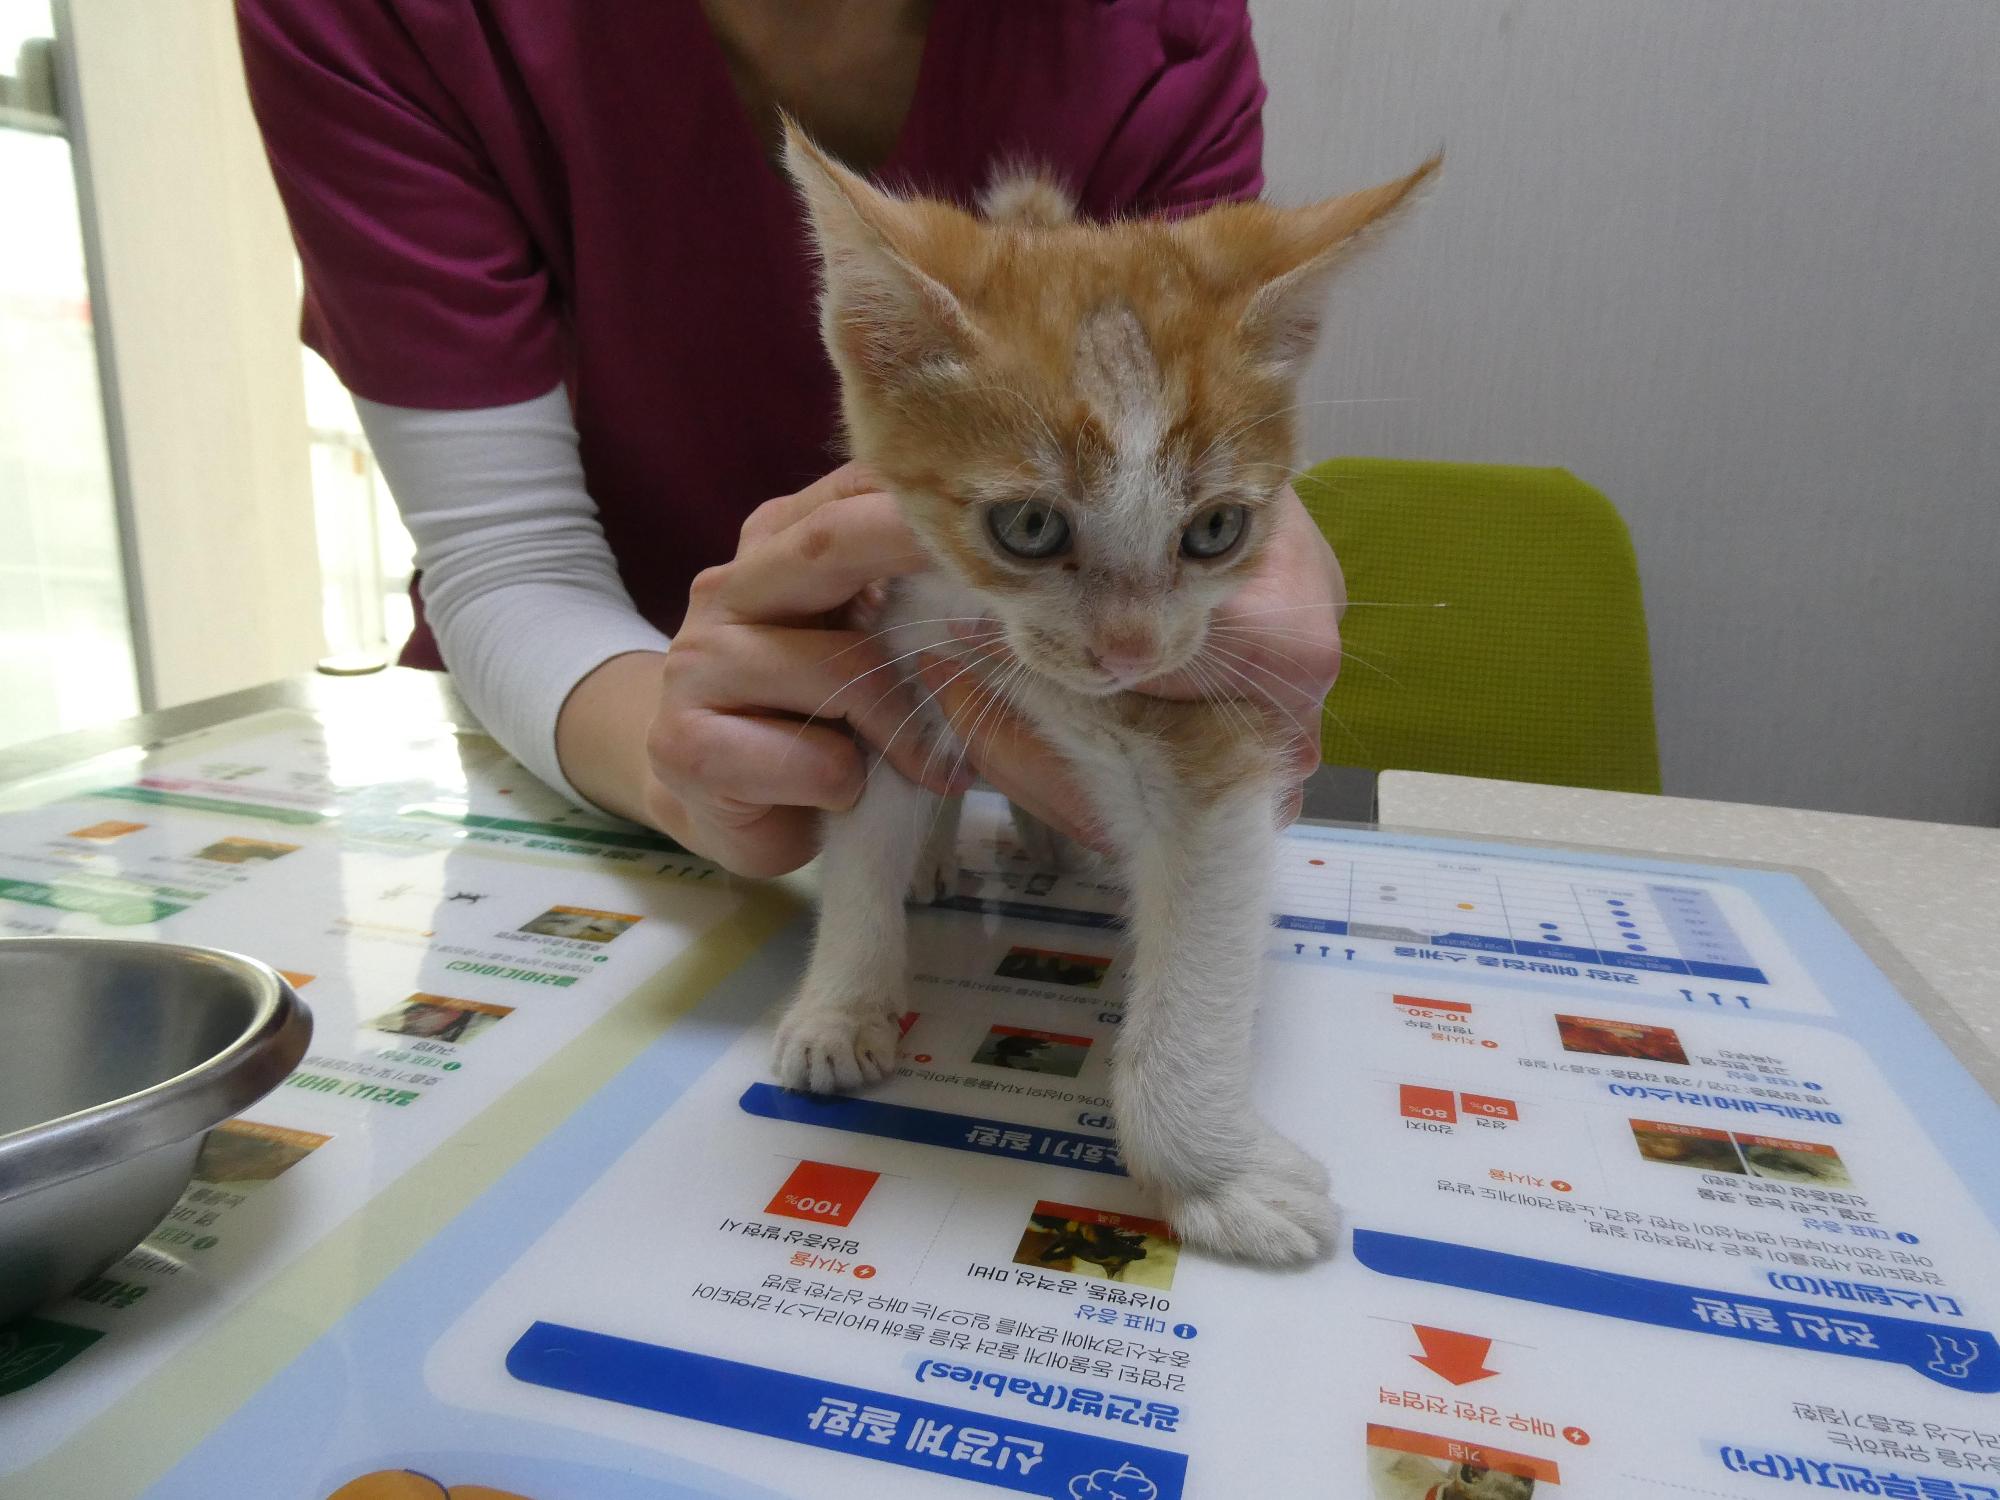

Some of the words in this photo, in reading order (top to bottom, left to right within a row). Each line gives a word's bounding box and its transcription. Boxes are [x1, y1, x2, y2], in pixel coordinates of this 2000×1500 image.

[1476, 955, 1578, 978] 예방접종
[1585, 968, 1639, 985] 권장
[1607, 1083, 1842, 1125] 아데노바이러스(A)
[1406, 1120, 1454, 1135] 강아지
[1476, 1118, 1507, 1131] 성견
[964, 1125, 1032, 1151] 질환
[1436, 1179, 1476, 1196] 발병
[1487, 1168, 1545, 1188] 치사율
[783, 1193, 843, 1217] 100%
[1790, 1188, 1869, 1207] 신경증상
[718, 1217, 740, 1233] 시
[742, 1222, 781, 1241] 발현
[1649, 1214, 1689, 1232] 약한
[1692, 1222, 1776, 1246] 면역성이
[1802, 1218, 1843, 1235] 증상
[1848, 1224, 1890, 1240] 대표
[781, 1229, 860, 1256] 임상증상
[1633, 1229, 1715, 1252] 치명적인
[1717, 1243, 1762, 1260] 높은
[1779, 1234, 1886, 1261] 강아지부터
[789, 1250, 850, 1275] 치사율
[1889, 1250, 1934, 1268] 어린
[761, 1273, 801, 1294] 질병
[966, 1262, 1009, 1282] 마비
[1013, 1268, 1078, 1296] 공격성,
[1857, 1262, 1946, 1287] 감염되면
[691, 1282, 773, 1311] 감염되어
[803, 1280, 864, 1305] 심각한
[866, 1293, 909, 1315] 매우
[1084, 1281, 1171, 1312] 이상행동,
[774, 1298, 880, 1333] 바이러스가
[911, 1301, 991, 1331] 일으키는
[1073, 1303, 1118, 1325] 증상
[1123, 1311, 1166, 1335] 대표
[1691, 1297, 1782, 1334] 질환
[881, 1319, 925, 1341] 통해
[927, 1329, 971, 1351] 침을
[995, 1316, 1059, 1345] 문제를
[1785, 1311, 1880, 1350] 전신
[975, 1337, 1020, 1361] 물려
[1061, 1329, 1191, 1369] 중추신경계에
[1024, 1346, 1114, 1378] 동물에게
[1118, 1364, 1187, 1392] 감염된
[914, 1359, 1180, 1433] 광견병(Rabies)
[1379, 1387, 1448, 1415] 전염력
[807, 1396, 901, 1445] 질환
[1453, 1400, 1502, 1426] 강한
[1505, 1414, 1556, 1438] 매우
[1923, 1423, 2000, 1448] 러스성
[905, 1417, 1044, 1476] 신경계
[1447, 1443, 1481, 1462] 기침
[1827, 1431, 1930, 1464] 유발하는
